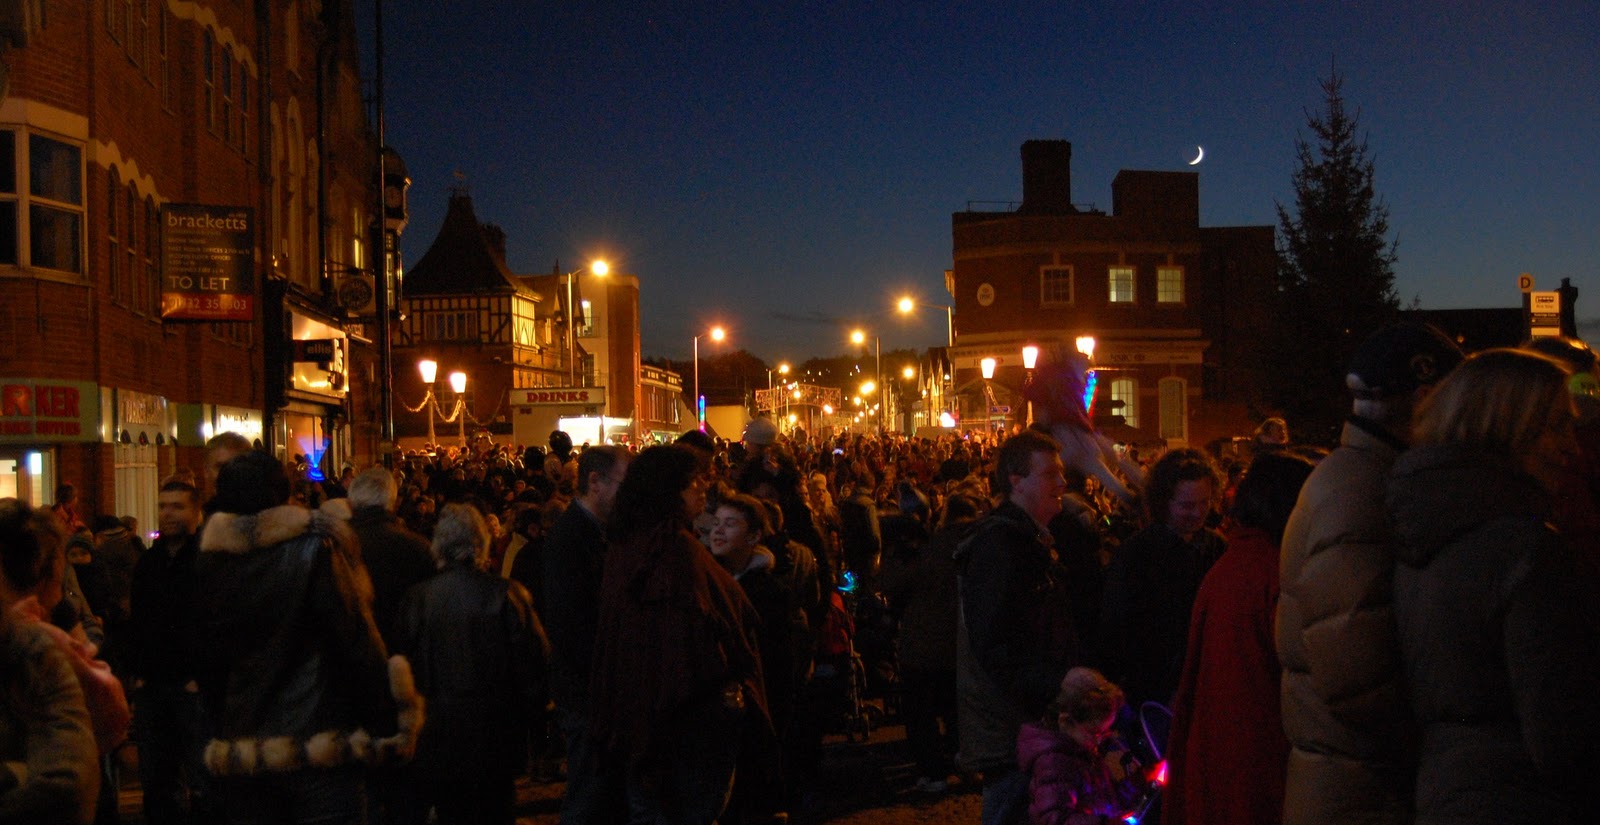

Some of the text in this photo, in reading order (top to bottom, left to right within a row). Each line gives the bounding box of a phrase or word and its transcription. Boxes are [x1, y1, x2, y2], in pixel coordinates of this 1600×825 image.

[167, 211, 247, 230] bracketts
[168, 276, 229, 291] TO LET
[1521, 277, 1531, 289] D
[307, 343, 332, 354] ellis
[0, 384, 80, 417] RKER
[527, 391, 589, 403] DRINKS
